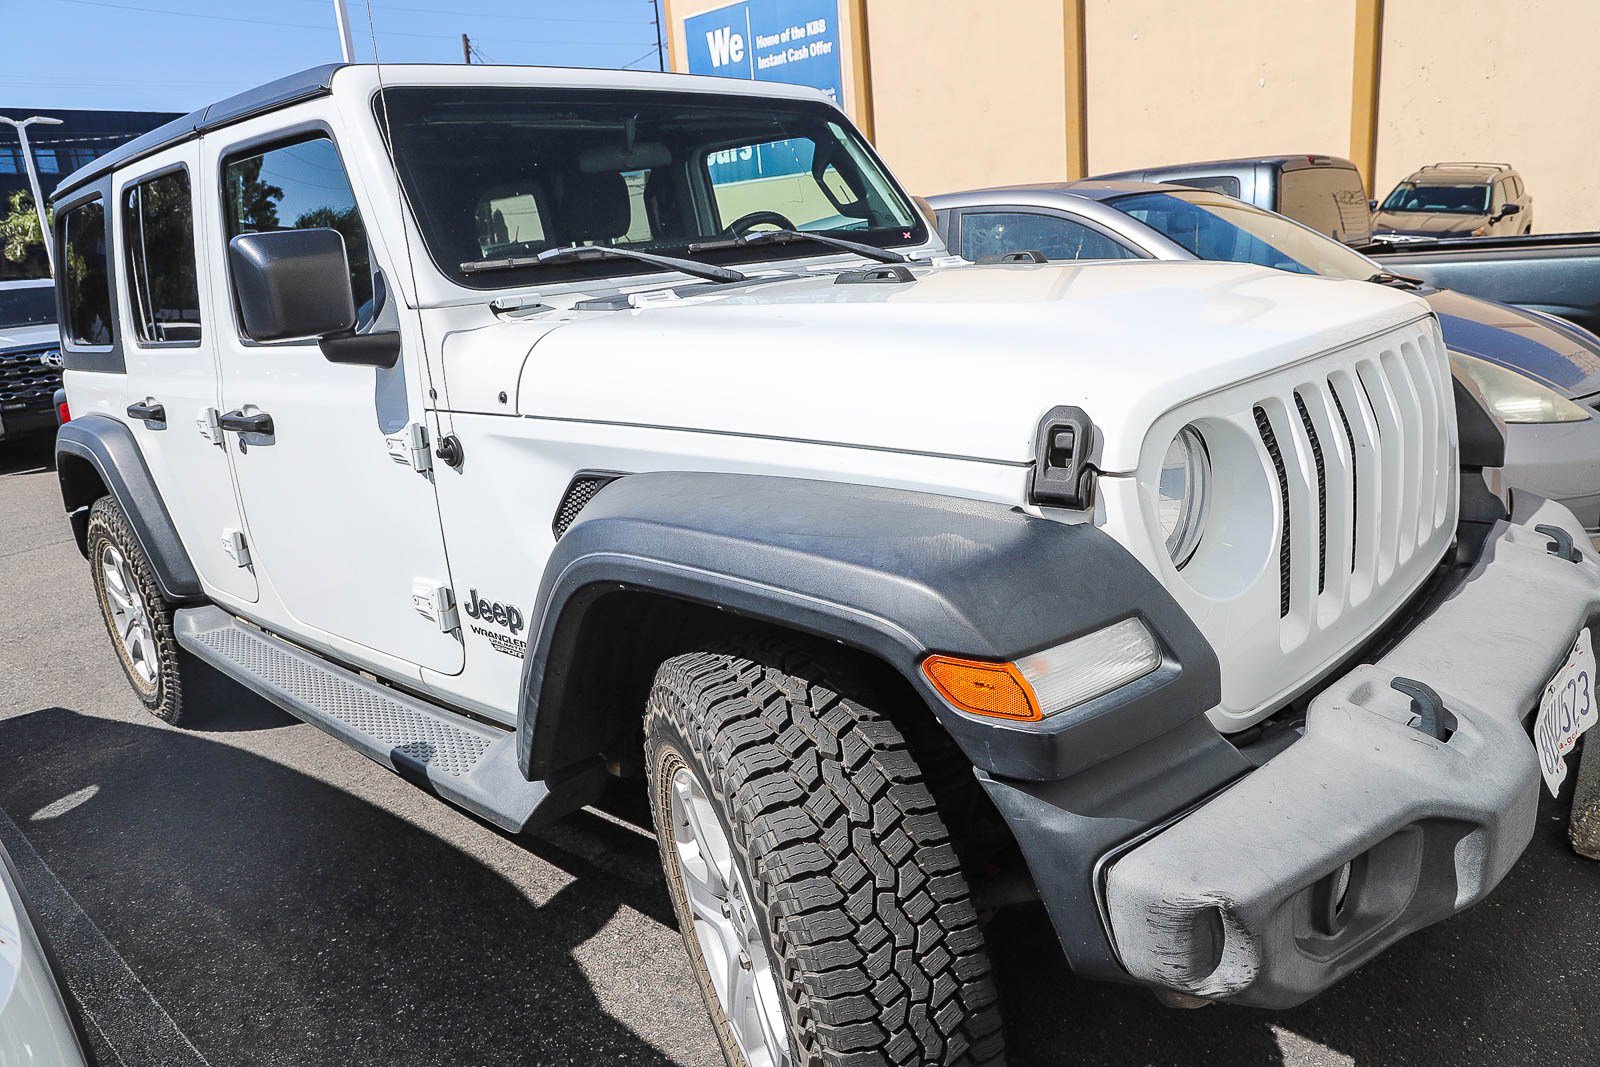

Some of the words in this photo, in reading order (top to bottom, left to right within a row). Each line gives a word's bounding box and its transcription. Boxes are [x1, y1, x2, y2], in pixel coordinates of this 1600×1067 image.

[706, 26, 744, 68] We
[756, 34, 780, 49] Home
[780, 28, 790, 43] of
[790, 25, 806, 40] the
[806, 18, 827, 36] KBB
[757, 50, 787, 70] Instant
[787, 45, 809, 63] Cash
[809, 40, 833, 57] Offer
[464, 587, 524, 635] Jeep
[470, 624, 527, 648] WRANGLER
